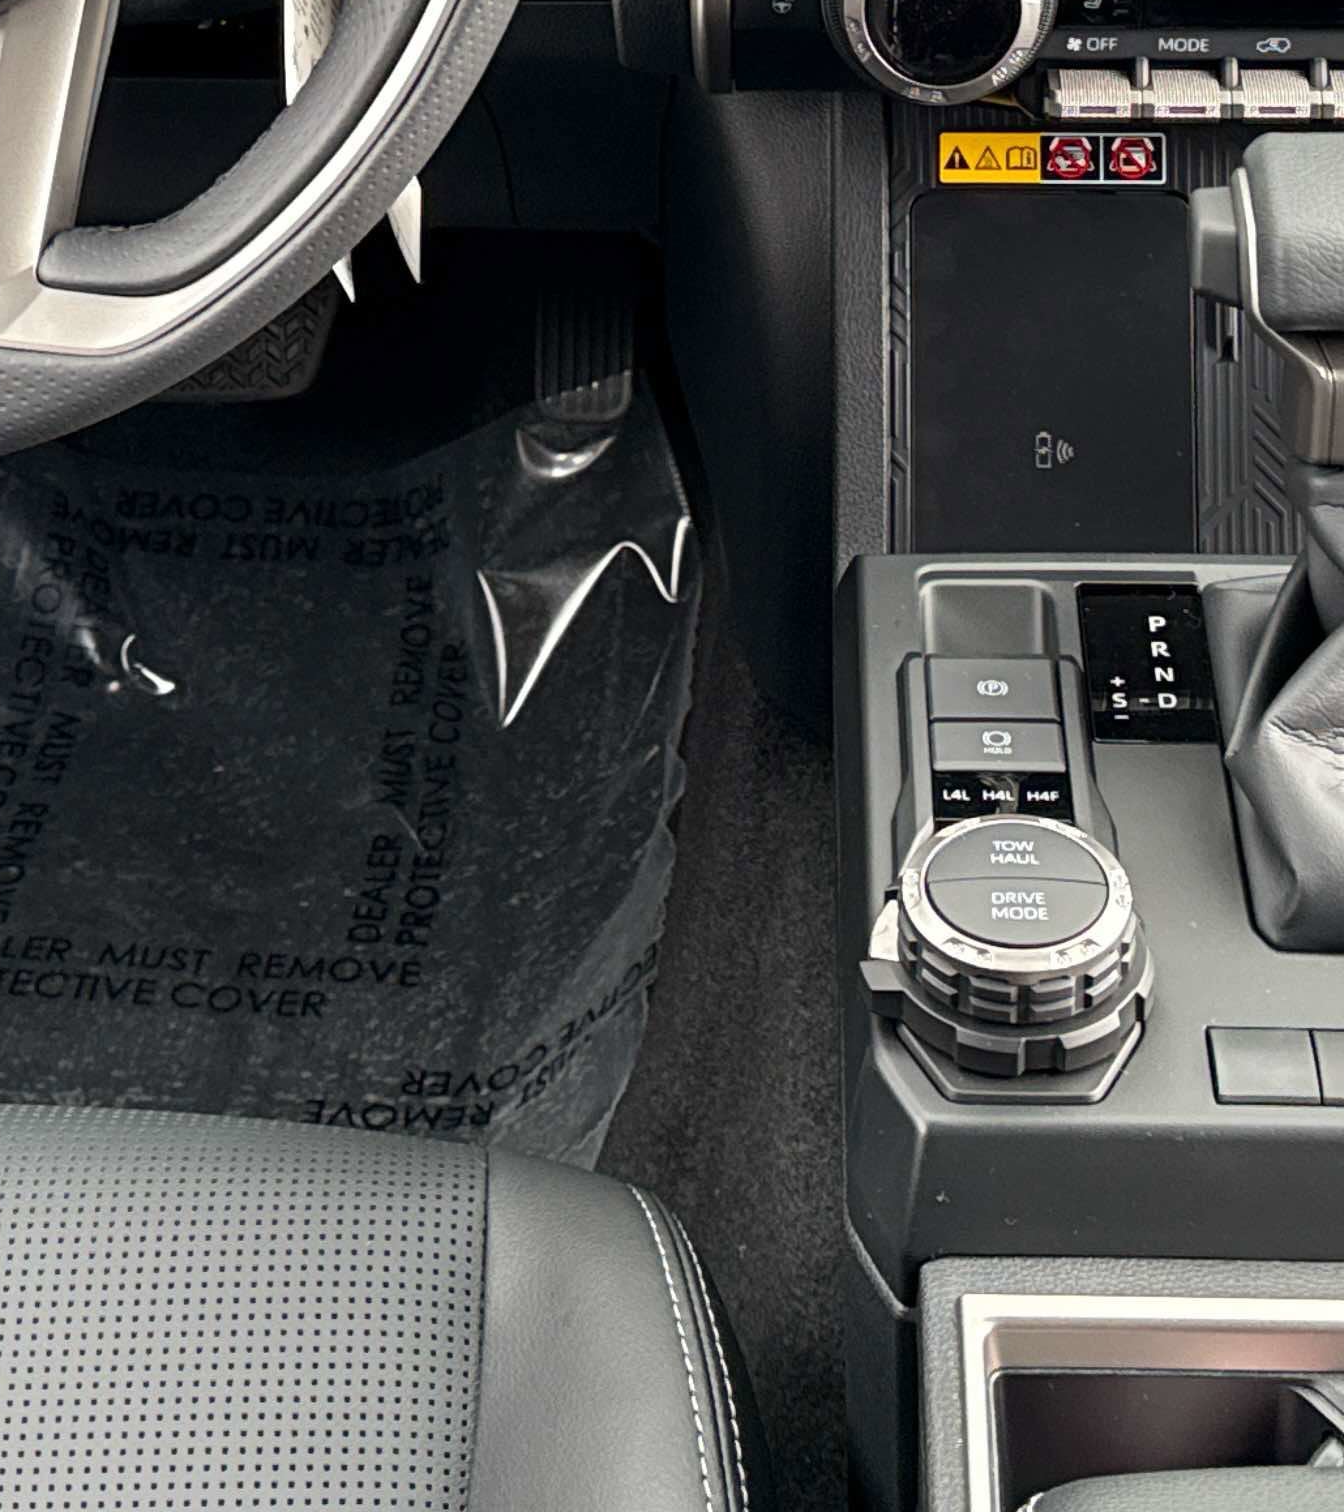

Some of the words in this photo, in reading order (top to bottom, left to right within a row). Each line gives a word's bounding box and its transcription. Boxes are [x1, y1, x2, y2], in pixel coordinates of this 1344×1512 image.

[1087, 38, 1118, 52] OFF
[1158, 38, 1210, 52] MODE
[116, 491, 253, 523] COVER
[219, 532, 320, 562] MUST
[1148, 615, 1167, 632] P
[389, 574, 435, 707] REMOVE
[1150, 641, 1171, 657] R
[1154, 667, 1175, 682] N
[1112, 694, 1128, 709] S
[1158, 694, 1178, 709] D
[32, 710, 83, 785] MUST
[373, 727, 417, 809] MUST
[393, 753, 457, 948] PROTECTIVE
[427, 640, 470, 745] COVER
[942, 790, 971, 802] L4L
[982, 790, 1016, 802] H4L
[1026, 790, 1060, 803] H4F
[992, 841, 1034, 852] TOW
[990, 853, 1040, 865] HAUL
[345, 832, 403, 944] DEALER
[991, 892, 1046, 905] DRIVE
[991, 908, 1049, 921] MODE
[97, 942, 213, 978] MUST
[236, 951, 427, 989] REMOVE
[170, 981, 330, 1020] COVER
[400, 1043, 549, 1097] COVER
[301, 1100, 496, 1131] REMOVE
